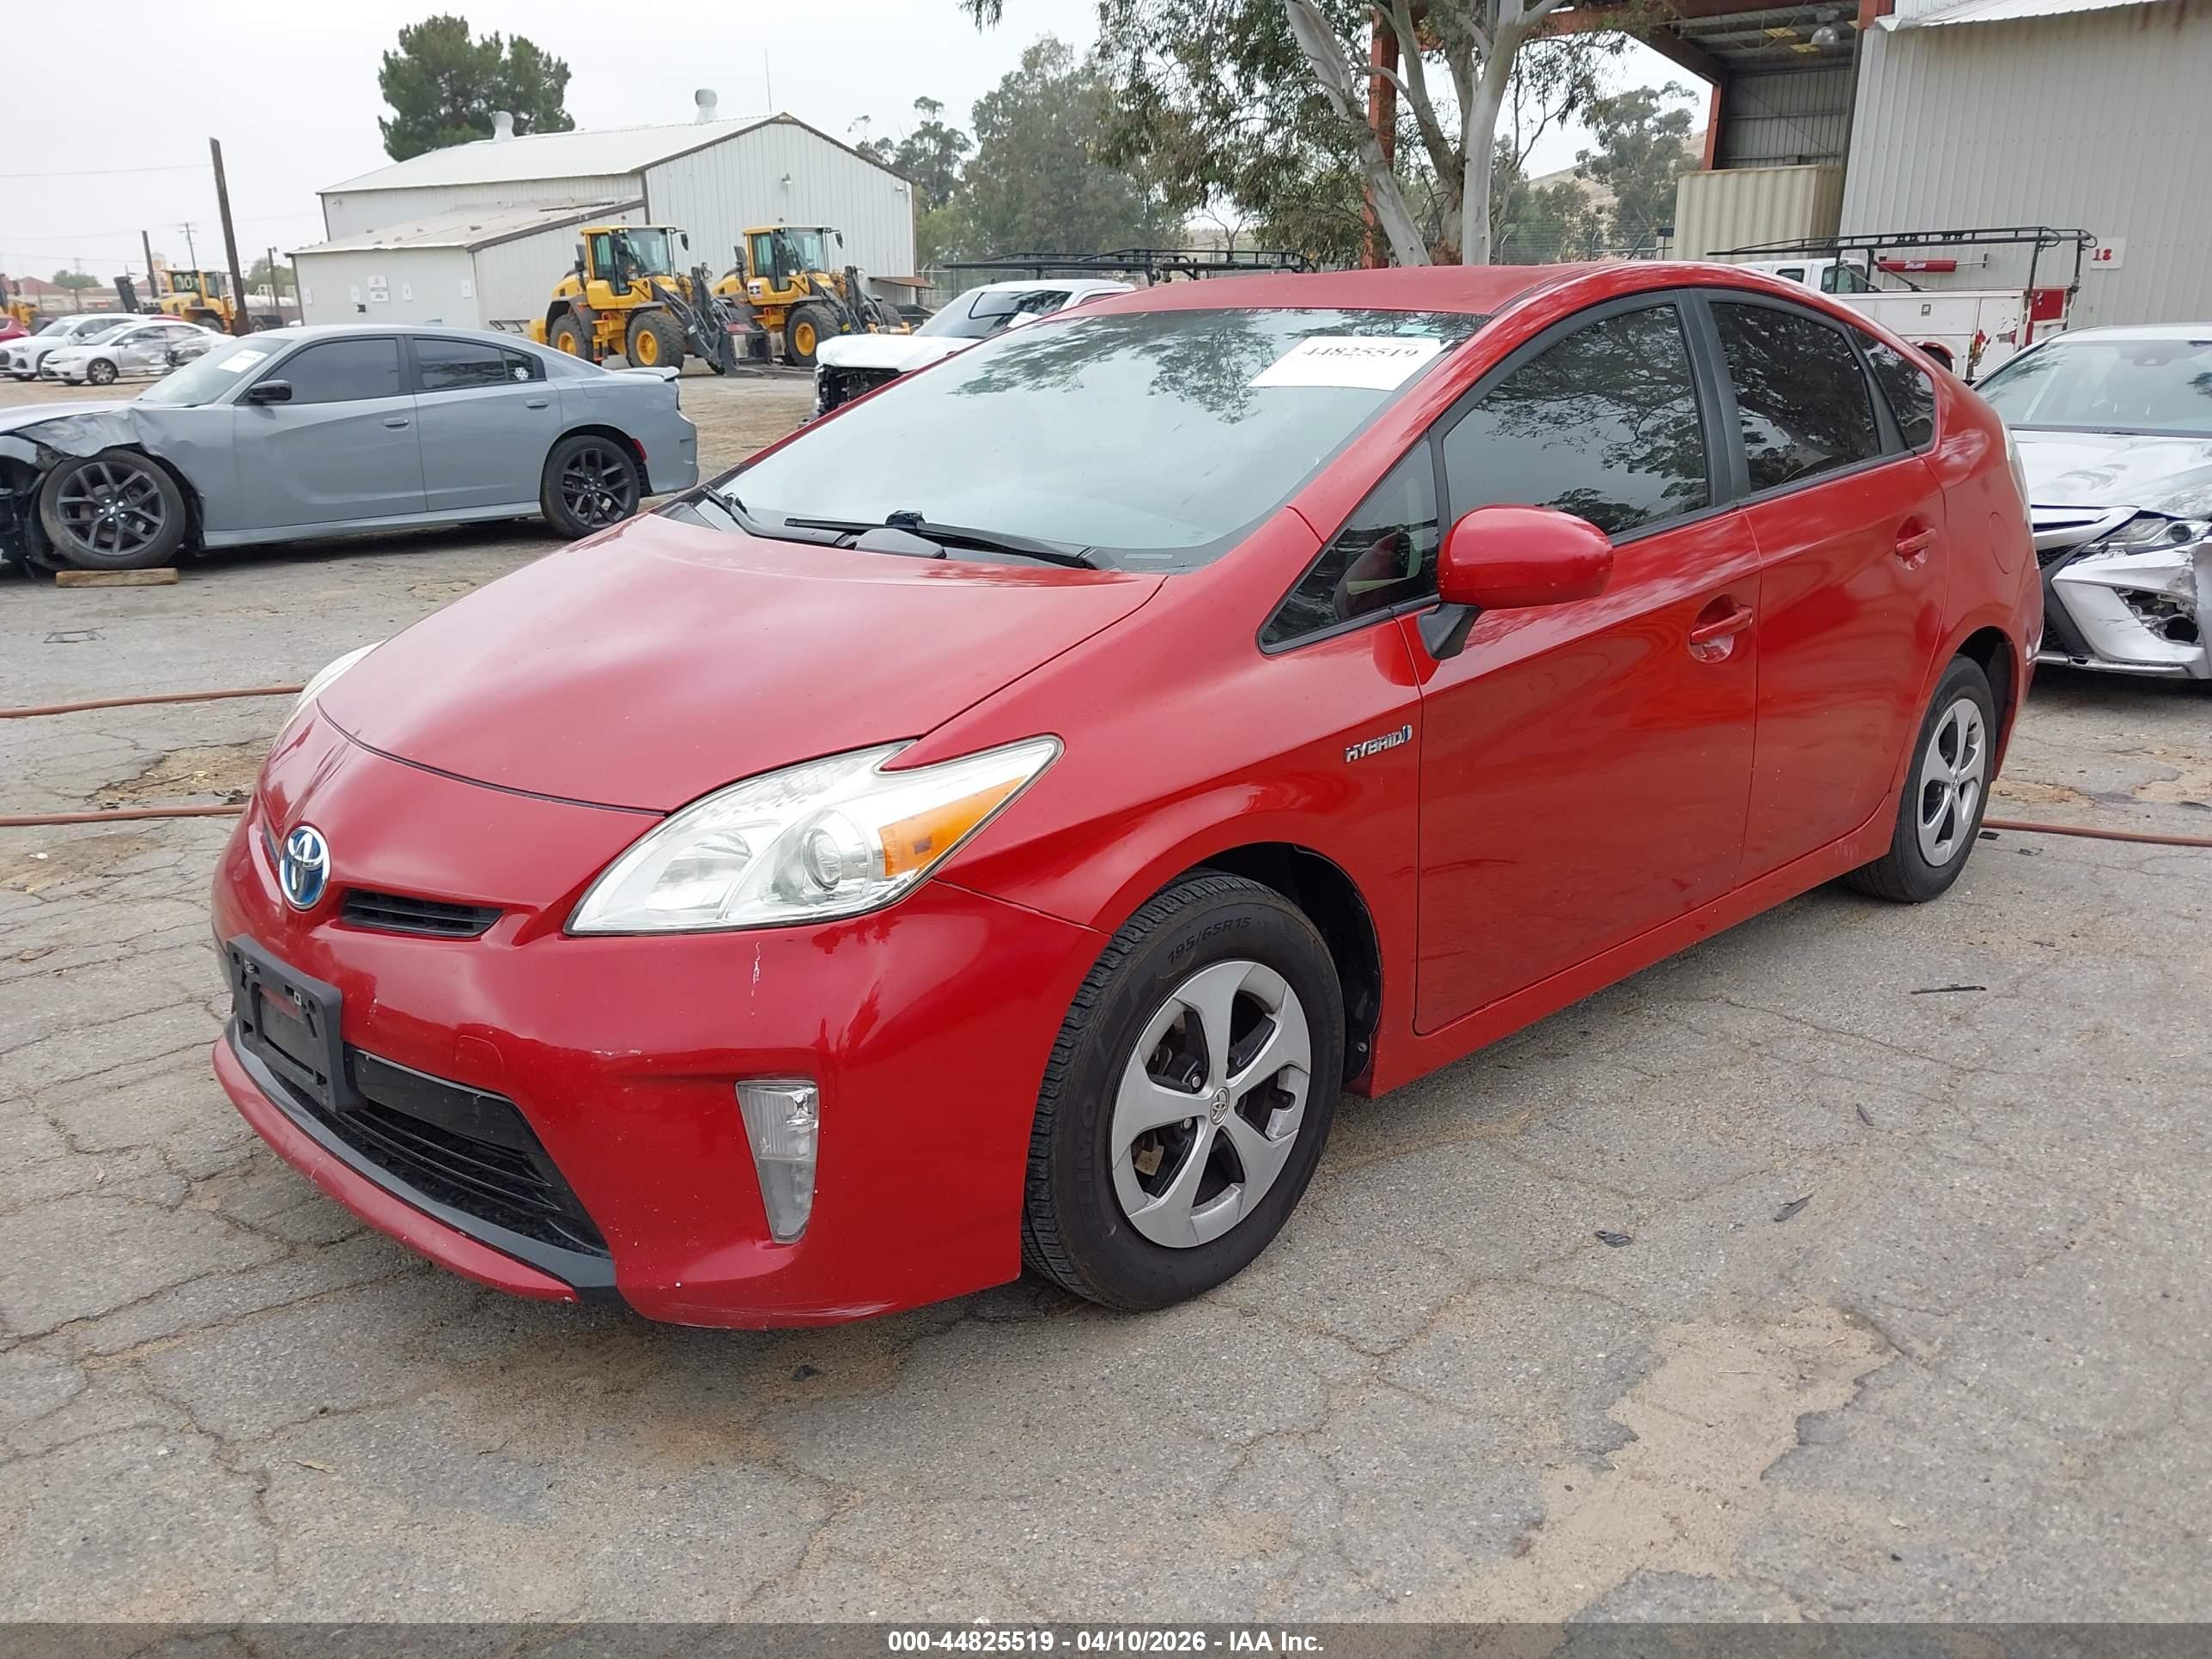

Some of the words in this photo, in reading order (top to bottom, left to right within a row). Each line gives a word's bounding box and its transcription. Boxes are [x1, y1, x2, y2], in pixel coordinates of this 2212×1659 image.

[2092, 248, 2112, 261] 18
[179, 274, 193, 290] 10
[1303, 346, 1419, 358] 44825519
[1344, 730, 1404, 763] HYBRID
[1167, 916, 1252, 964] 195/65R15
